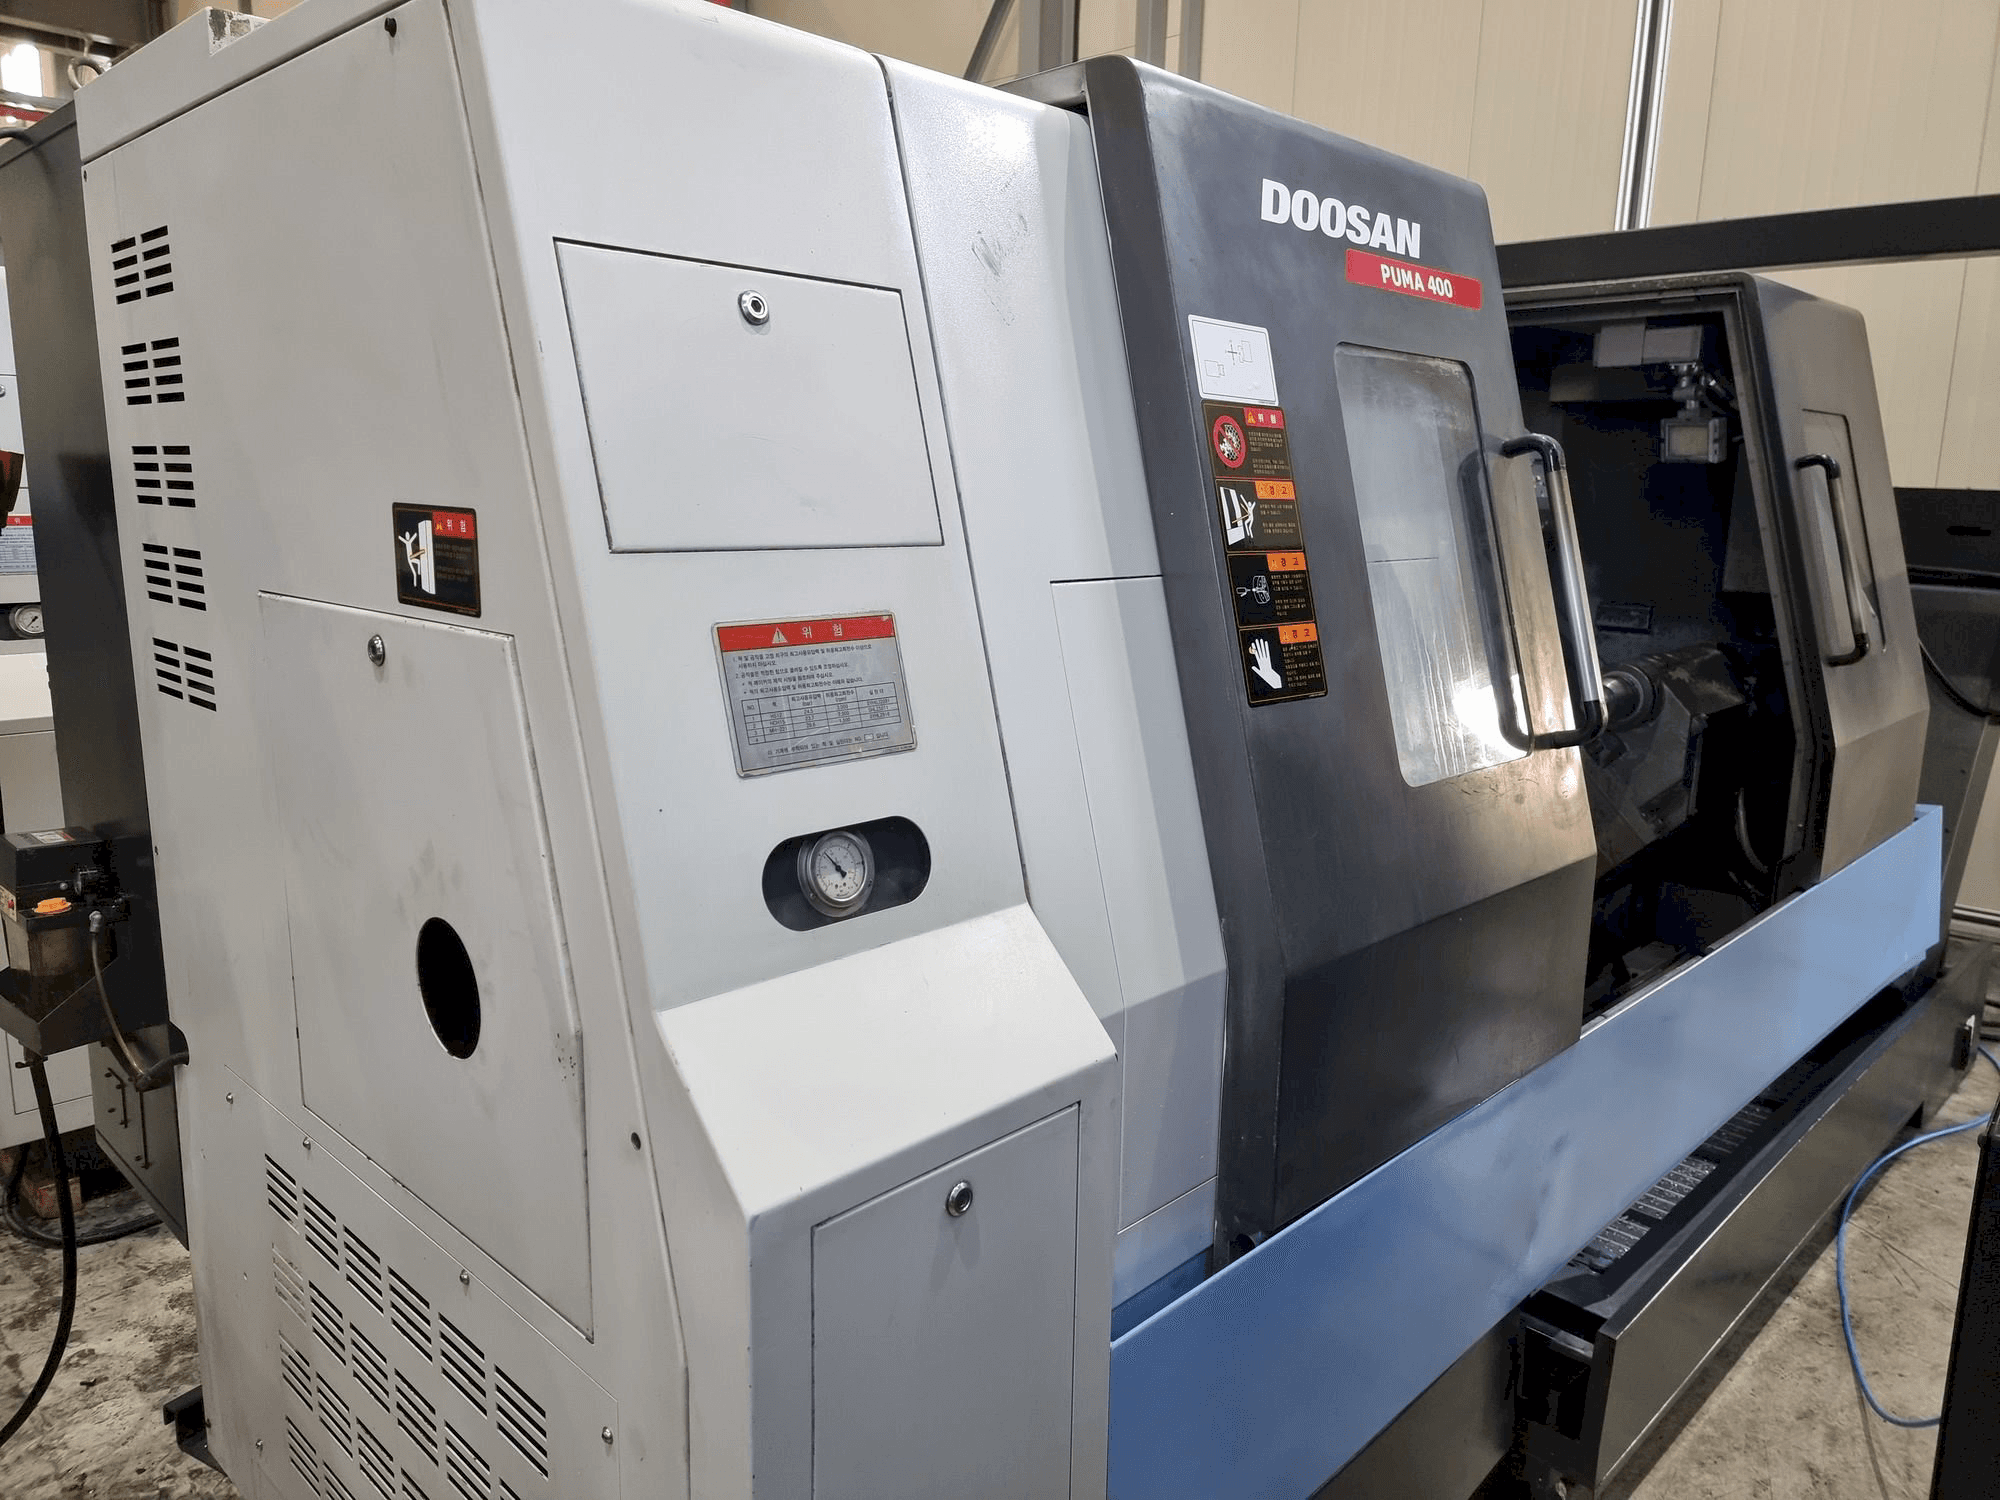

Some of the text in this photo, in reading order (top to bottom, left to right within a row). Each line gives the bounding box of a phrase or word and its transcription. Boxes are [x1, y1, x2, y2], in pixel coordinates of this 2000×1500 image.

[1261, 178, 1421, 259] DOOSAN
[1380, 263, 1453, 298] PUMA 400
